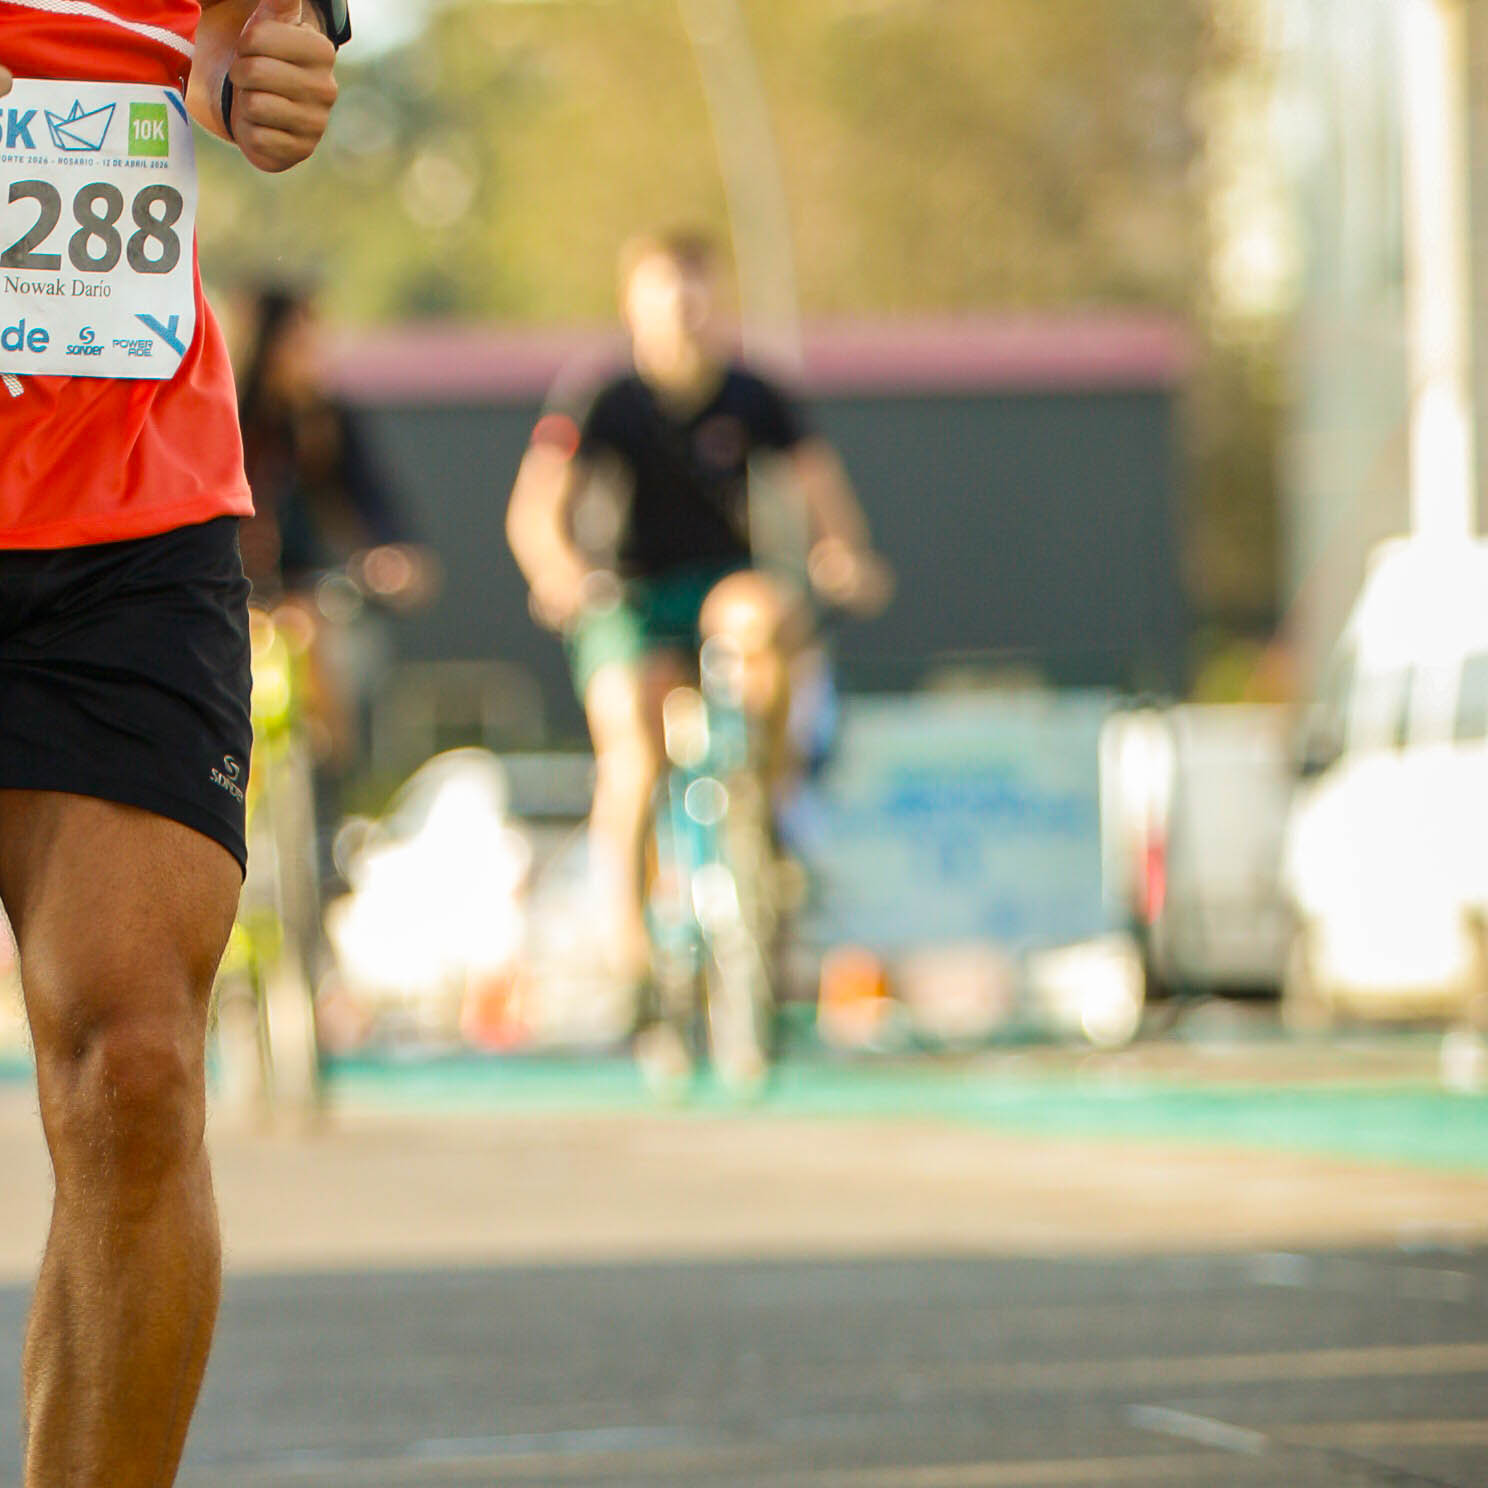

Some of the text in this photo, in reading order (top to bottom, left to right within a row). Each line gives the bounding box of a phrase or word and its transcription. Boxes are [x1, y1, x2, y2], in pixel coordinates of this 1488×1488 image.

[132, 119, 165, 141] 10K
[27, 155, 48, 165] 2026
[57, 156, 94, 166] ROSARIO
[112, 159, 122, 167] DE
[124, 159, 147, 168] ABRIL
[3, 275, 111, 297] Nowak Darío
[112, 339, 153, 349] POWER
